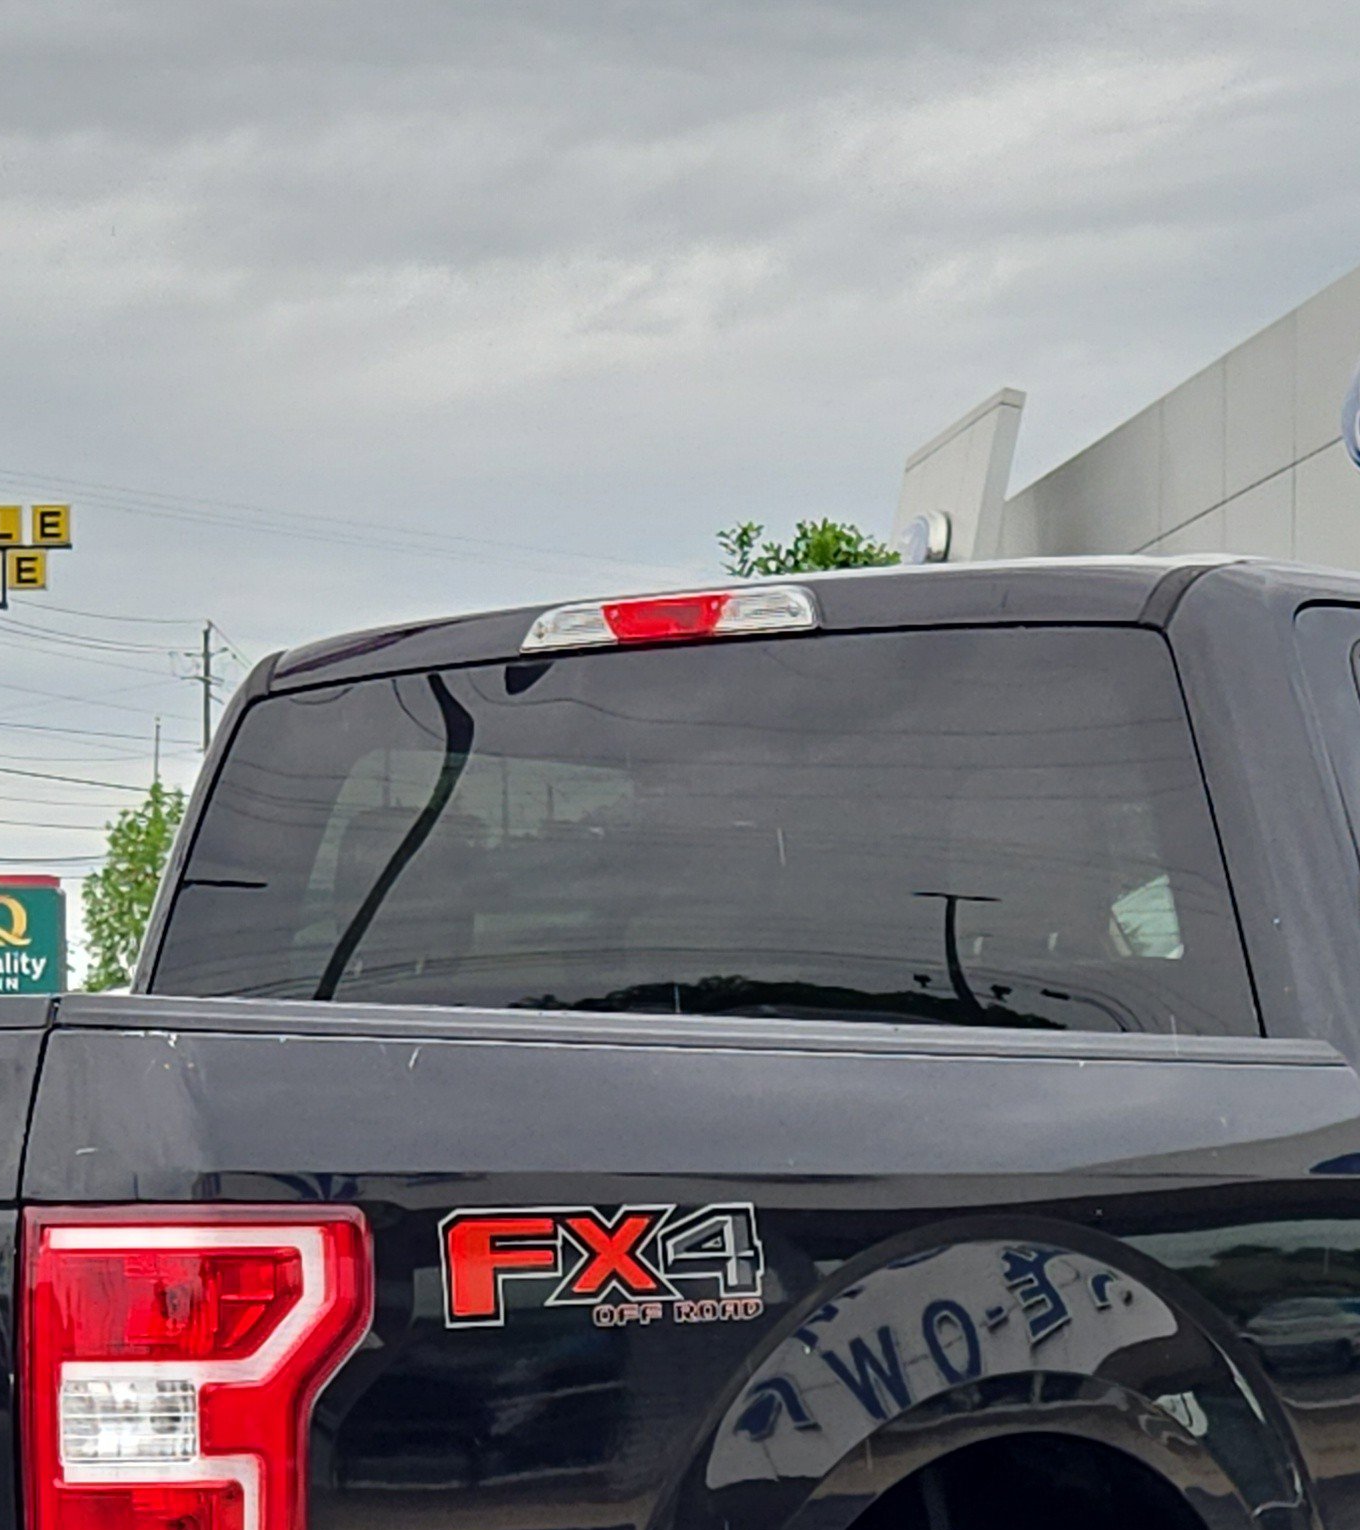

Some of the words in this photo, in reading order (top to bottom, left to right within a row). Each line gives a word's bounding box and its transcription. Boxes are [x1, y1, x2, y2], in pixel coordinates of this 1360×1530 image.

[438, 1202, 765, 1329] FX4
[592, 1302, 664, 1328] OFF
[674, 1296, 764, 1325] ROAD
